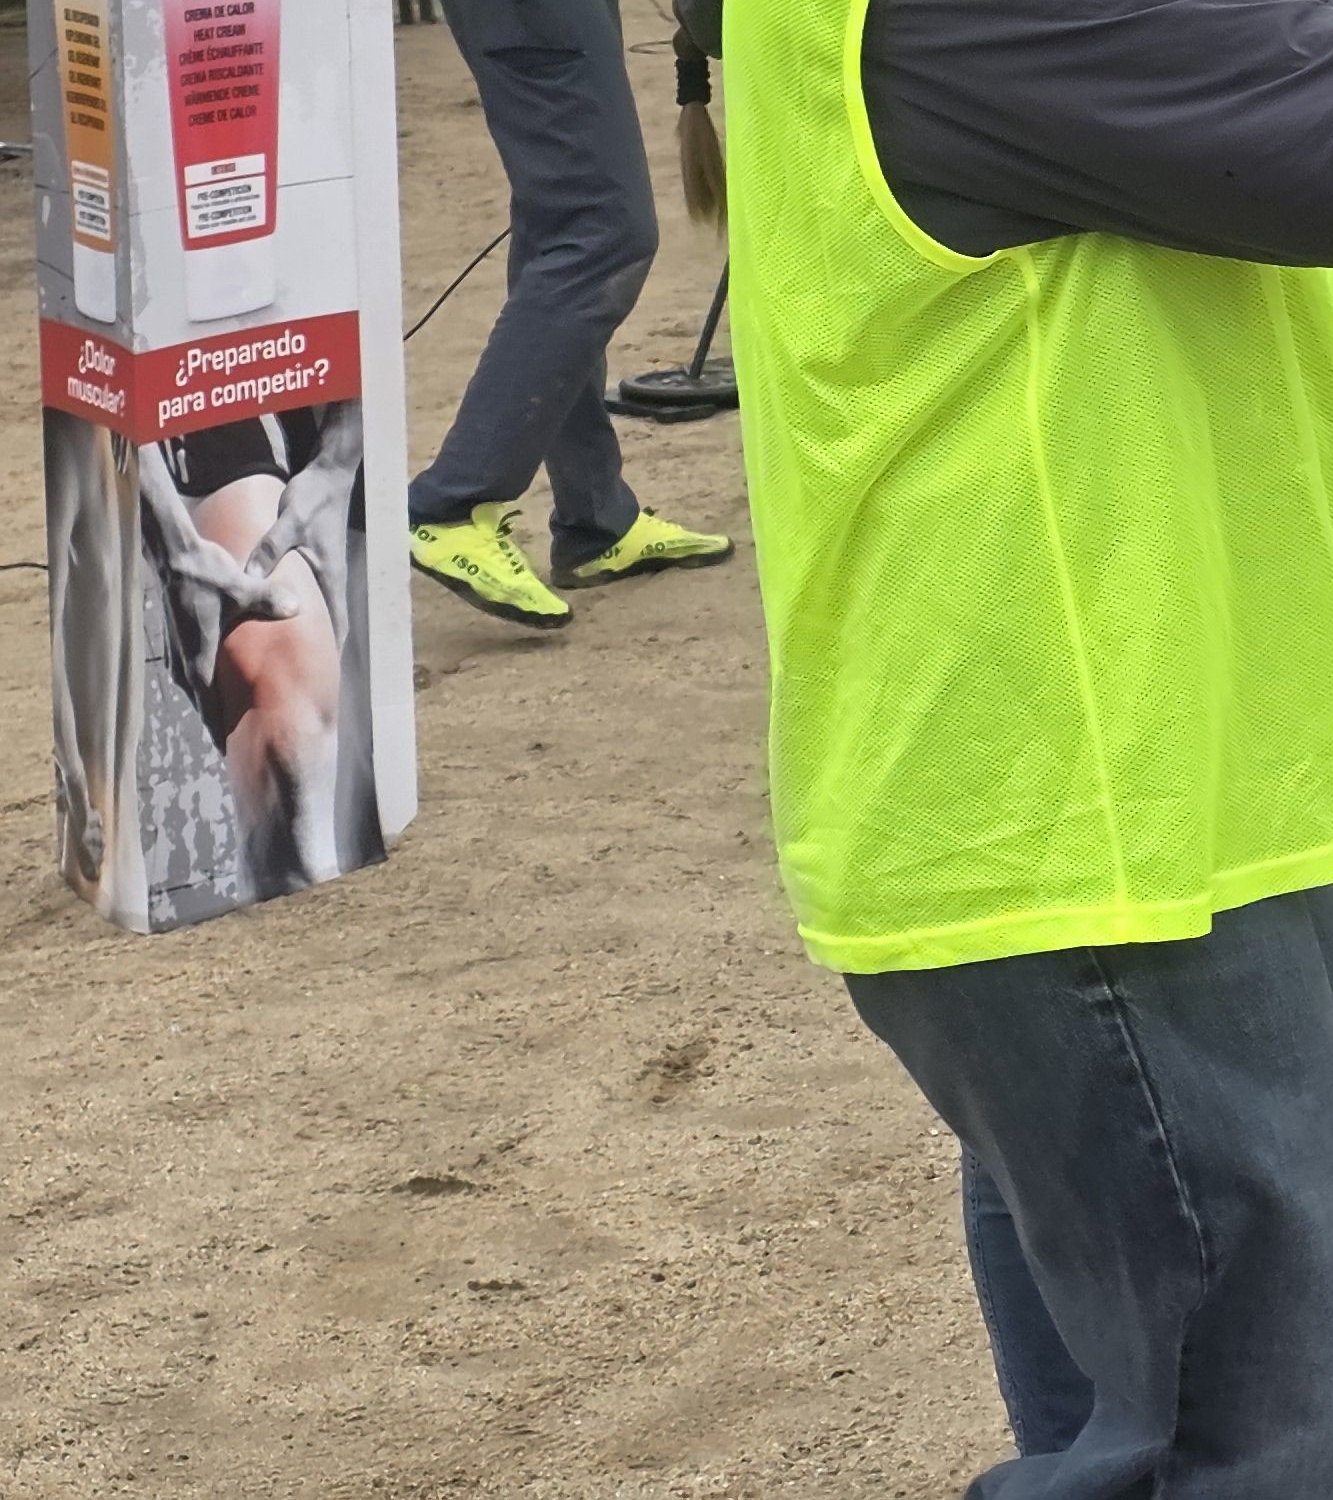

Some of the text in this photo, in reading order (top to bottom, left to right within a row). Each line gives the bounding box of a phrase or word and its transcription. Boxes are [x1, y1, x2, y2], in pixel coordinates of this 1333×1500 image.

[226, 2, 255, 18] CALOR
[194, 23, 246, 41] HEAT CREAM
[78, 339, 115, 377] ¿Dolor
[175, 329, 306, 387] ¿Preparado
[68, 375, 125, 417] muscular?
[158, 358, 330, 428] para competir?
